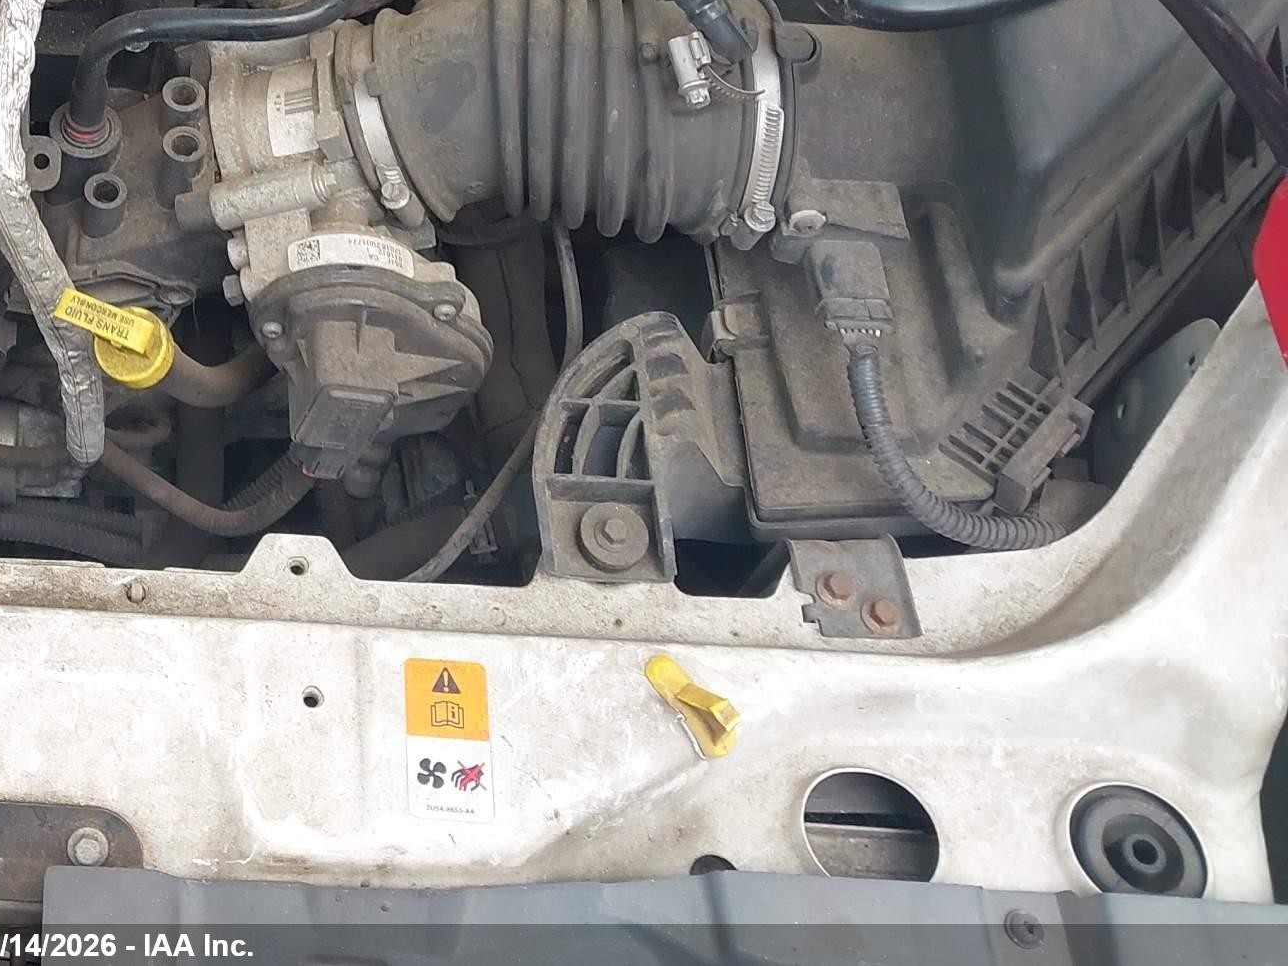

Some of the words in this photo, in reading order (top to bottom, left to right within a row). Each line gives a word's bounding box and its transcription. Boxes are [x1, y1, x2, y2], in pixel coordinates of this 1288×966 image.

[64, 305, 95, 325] FLUID
[118, 314, 136, 329] USE
[95, 319, 130, 341] TRANS
